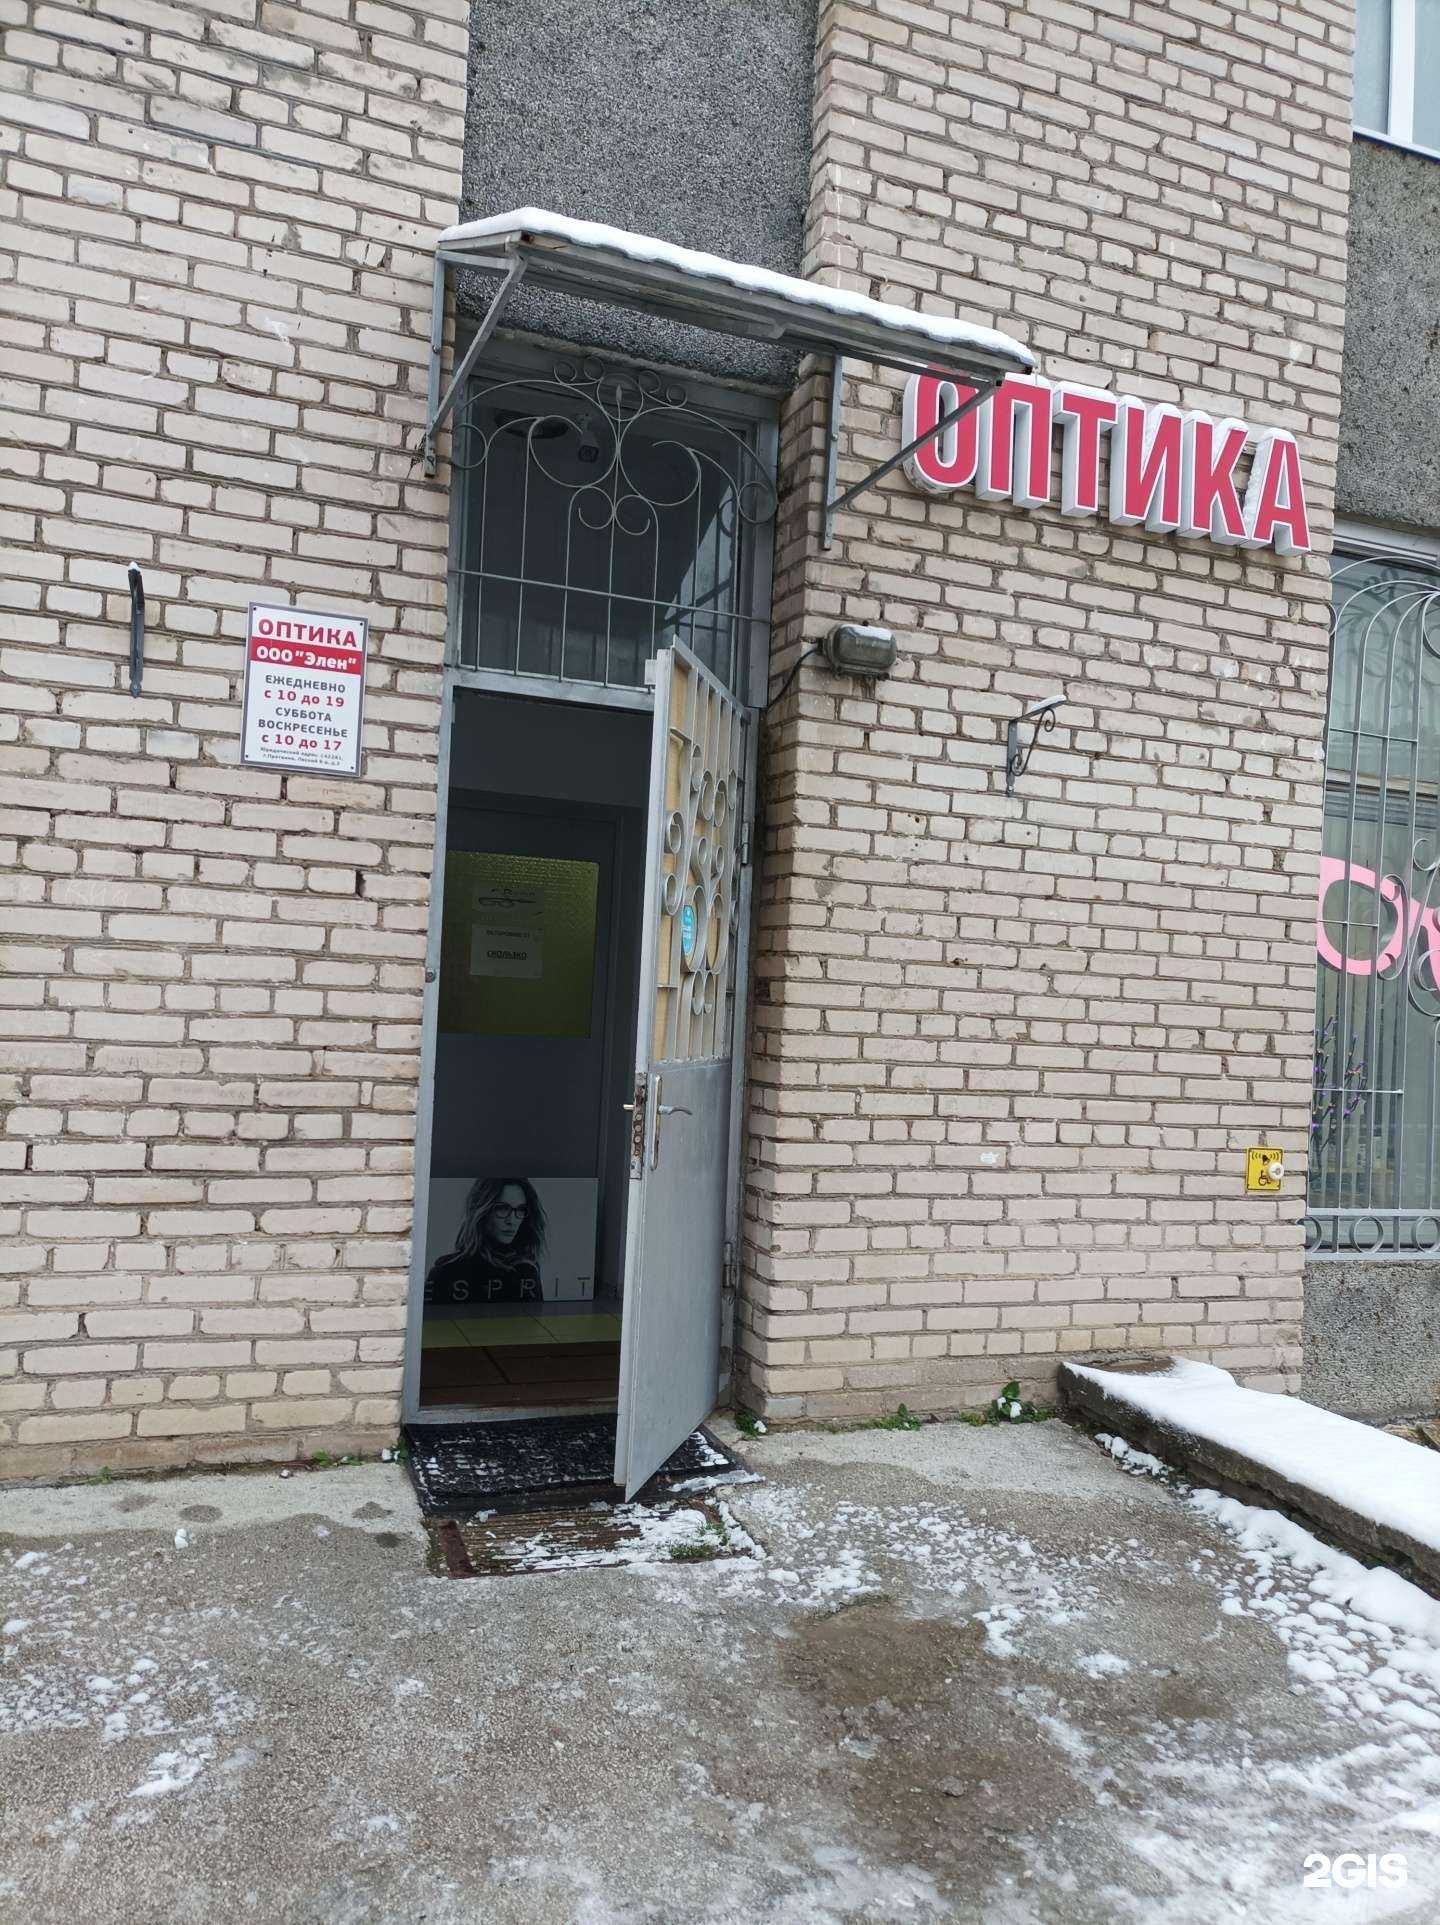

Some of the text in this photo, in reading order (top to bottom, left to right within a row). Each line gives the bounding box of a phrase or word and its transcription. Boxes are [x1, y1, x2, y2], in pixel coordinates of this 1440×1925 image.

[904, 366, 1311, 554] ОПТИКА
[258, 618, 357, 647] ОПТИКА
[256, 645, 357, 670] ООО "Элен"
[265, 674, 346, 693] ЕЖЕДНЕВНО
[264, 690, 345, 707] с 10 до 19
[275, 707, 333, 722] СУББОТА
[258, 719, 348, 738] ВОСКРЕСЕНЬЕ
[261, 734, 342, 751] с 10 до 17
[424, 1277, 591, 1301] ESPRIT
